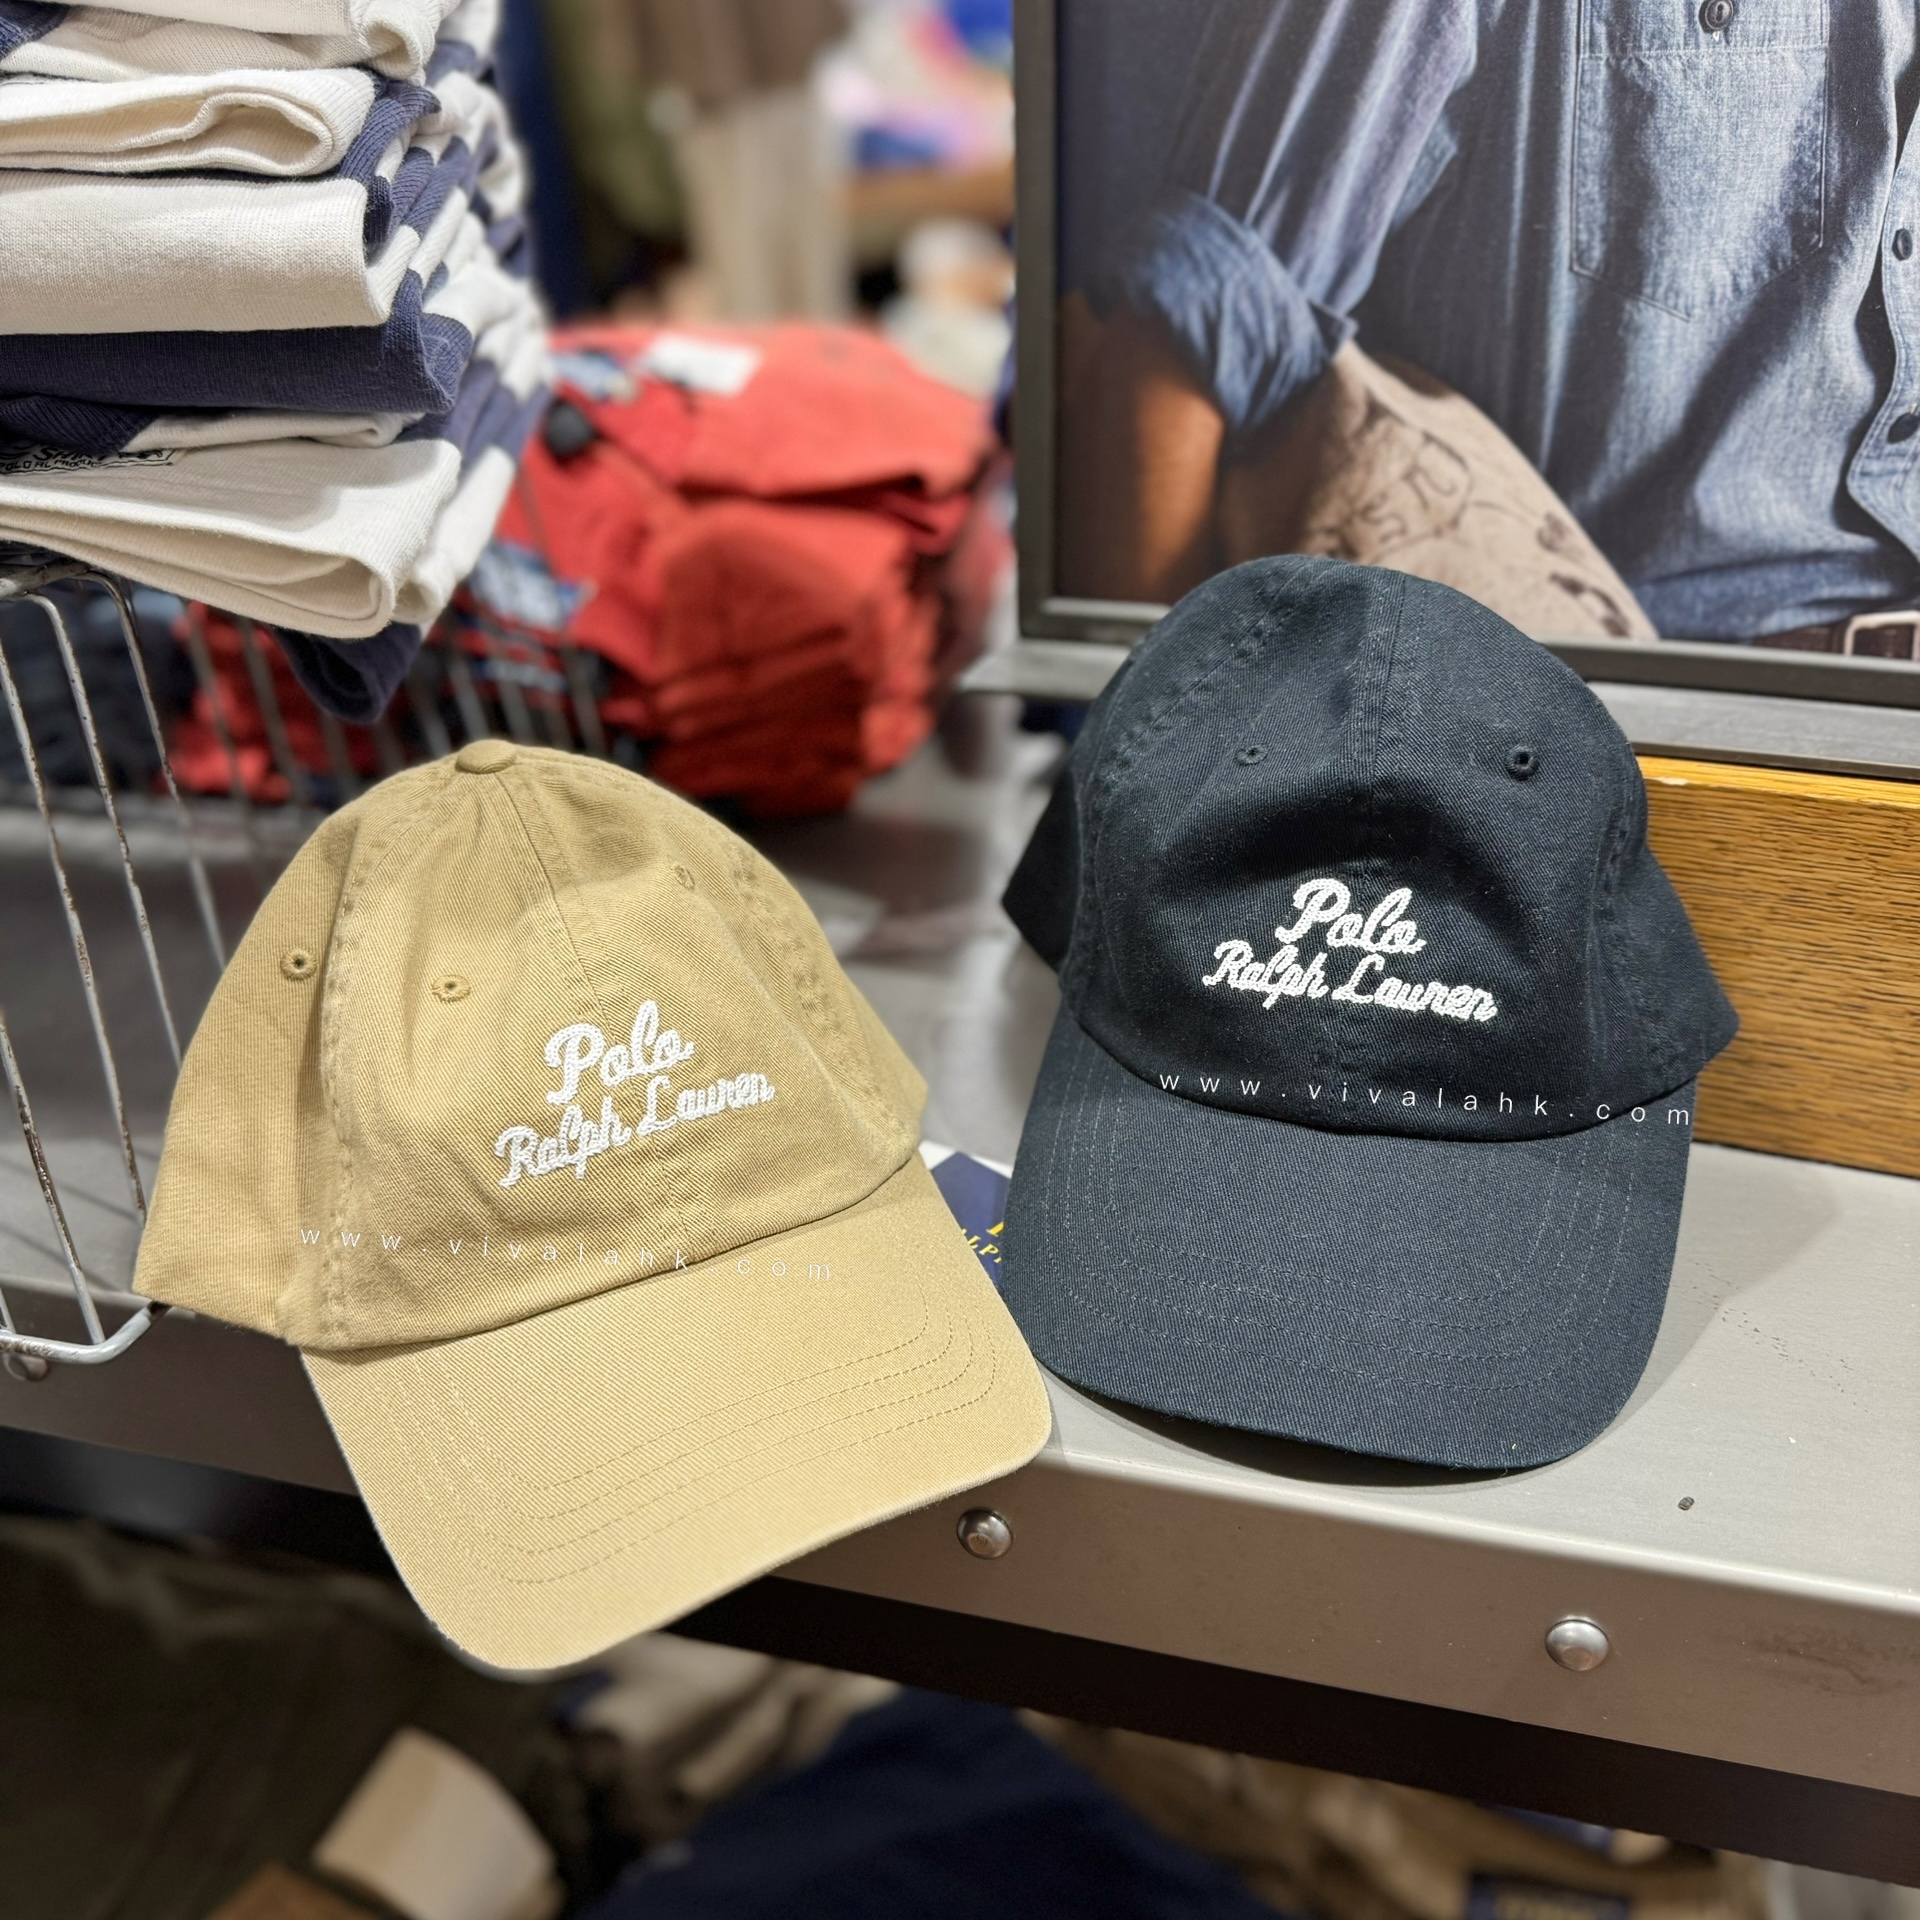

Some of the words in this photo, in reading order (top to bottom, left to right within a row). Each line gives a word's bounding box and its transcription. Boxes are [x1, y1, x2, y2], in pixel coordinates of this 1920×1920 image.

[1274, 877, 1427, 955] Polo
[1202, 938, 1329, 1010] Ralph
[1331, 953, 1498, 1022] Lauren
[544, 998, 696, 1105] Polo
[494, 1095, 632, 1189] Ralph
[636, 1072, 776, 1137] Lauren
